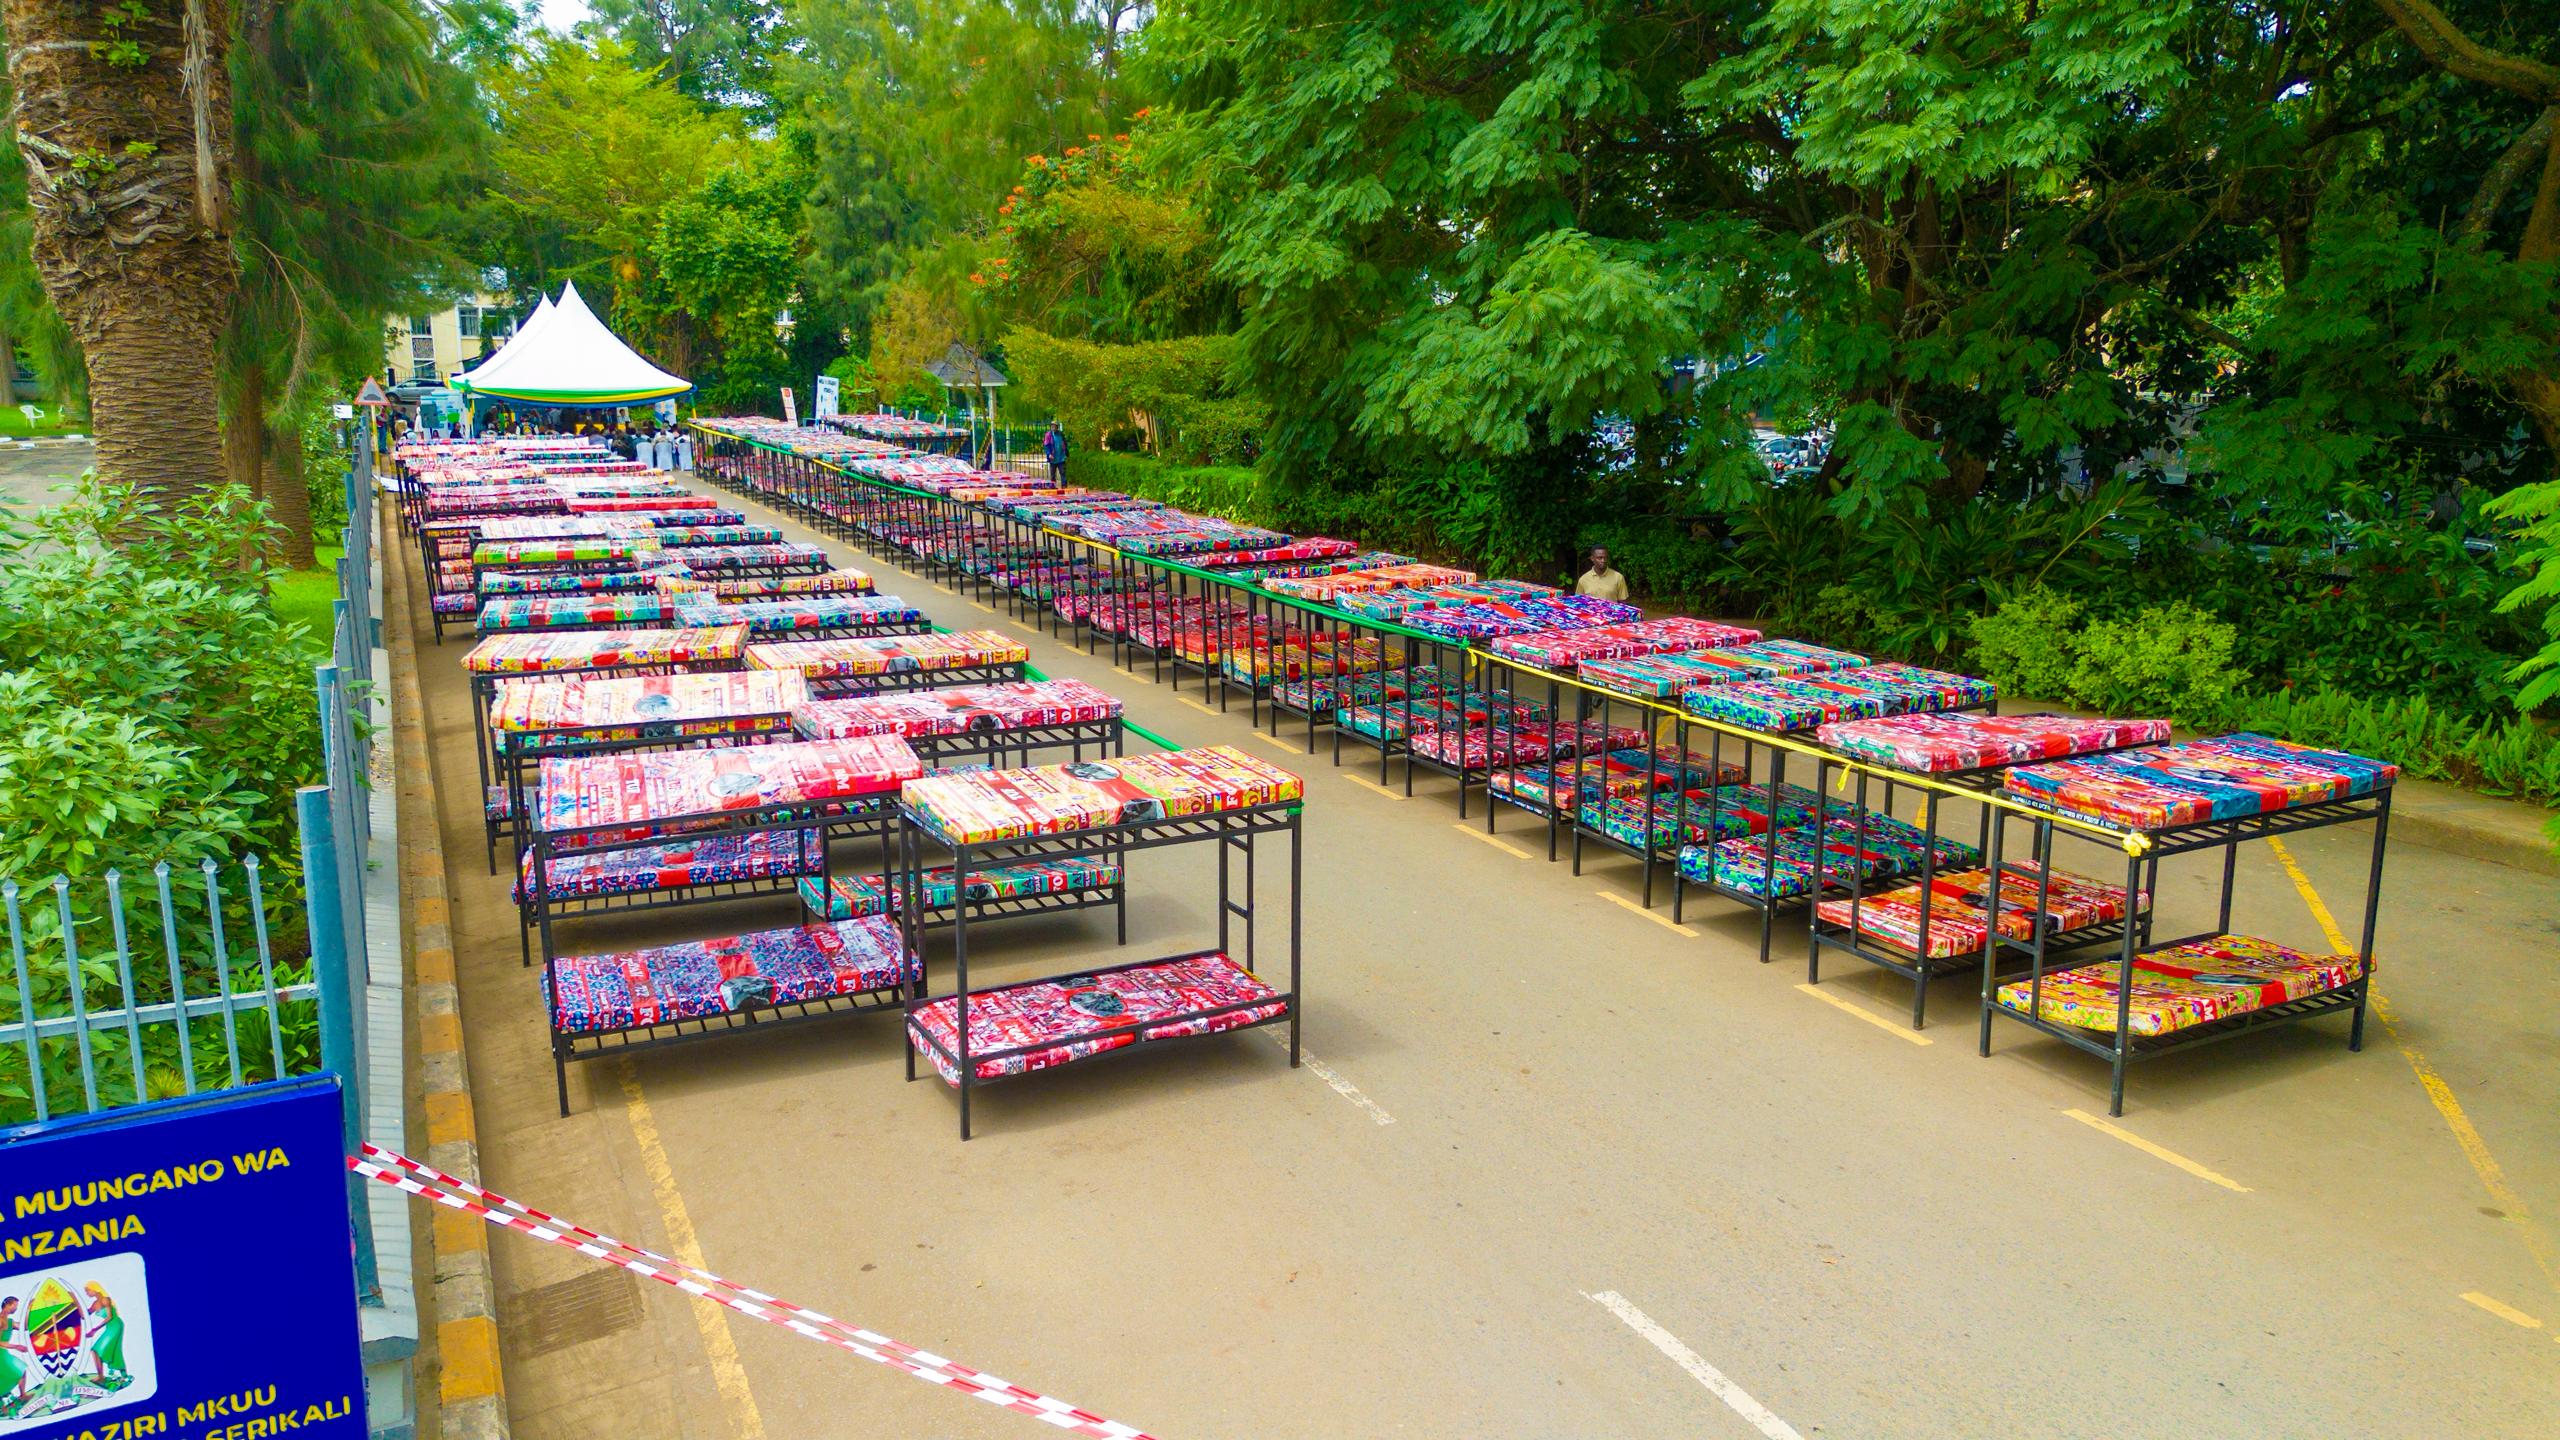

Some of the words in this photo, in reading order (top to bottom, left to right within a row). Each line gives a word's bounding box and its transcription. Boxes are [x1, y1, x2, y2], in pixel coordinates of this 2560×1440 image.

[14, 1159, 225, 1219] MUUNGANO
[232, 1147, 290, 1175] WA
[0, 1214, 146, 1264] NZANIA
[177, 1384, 277, 1427] MKUU
